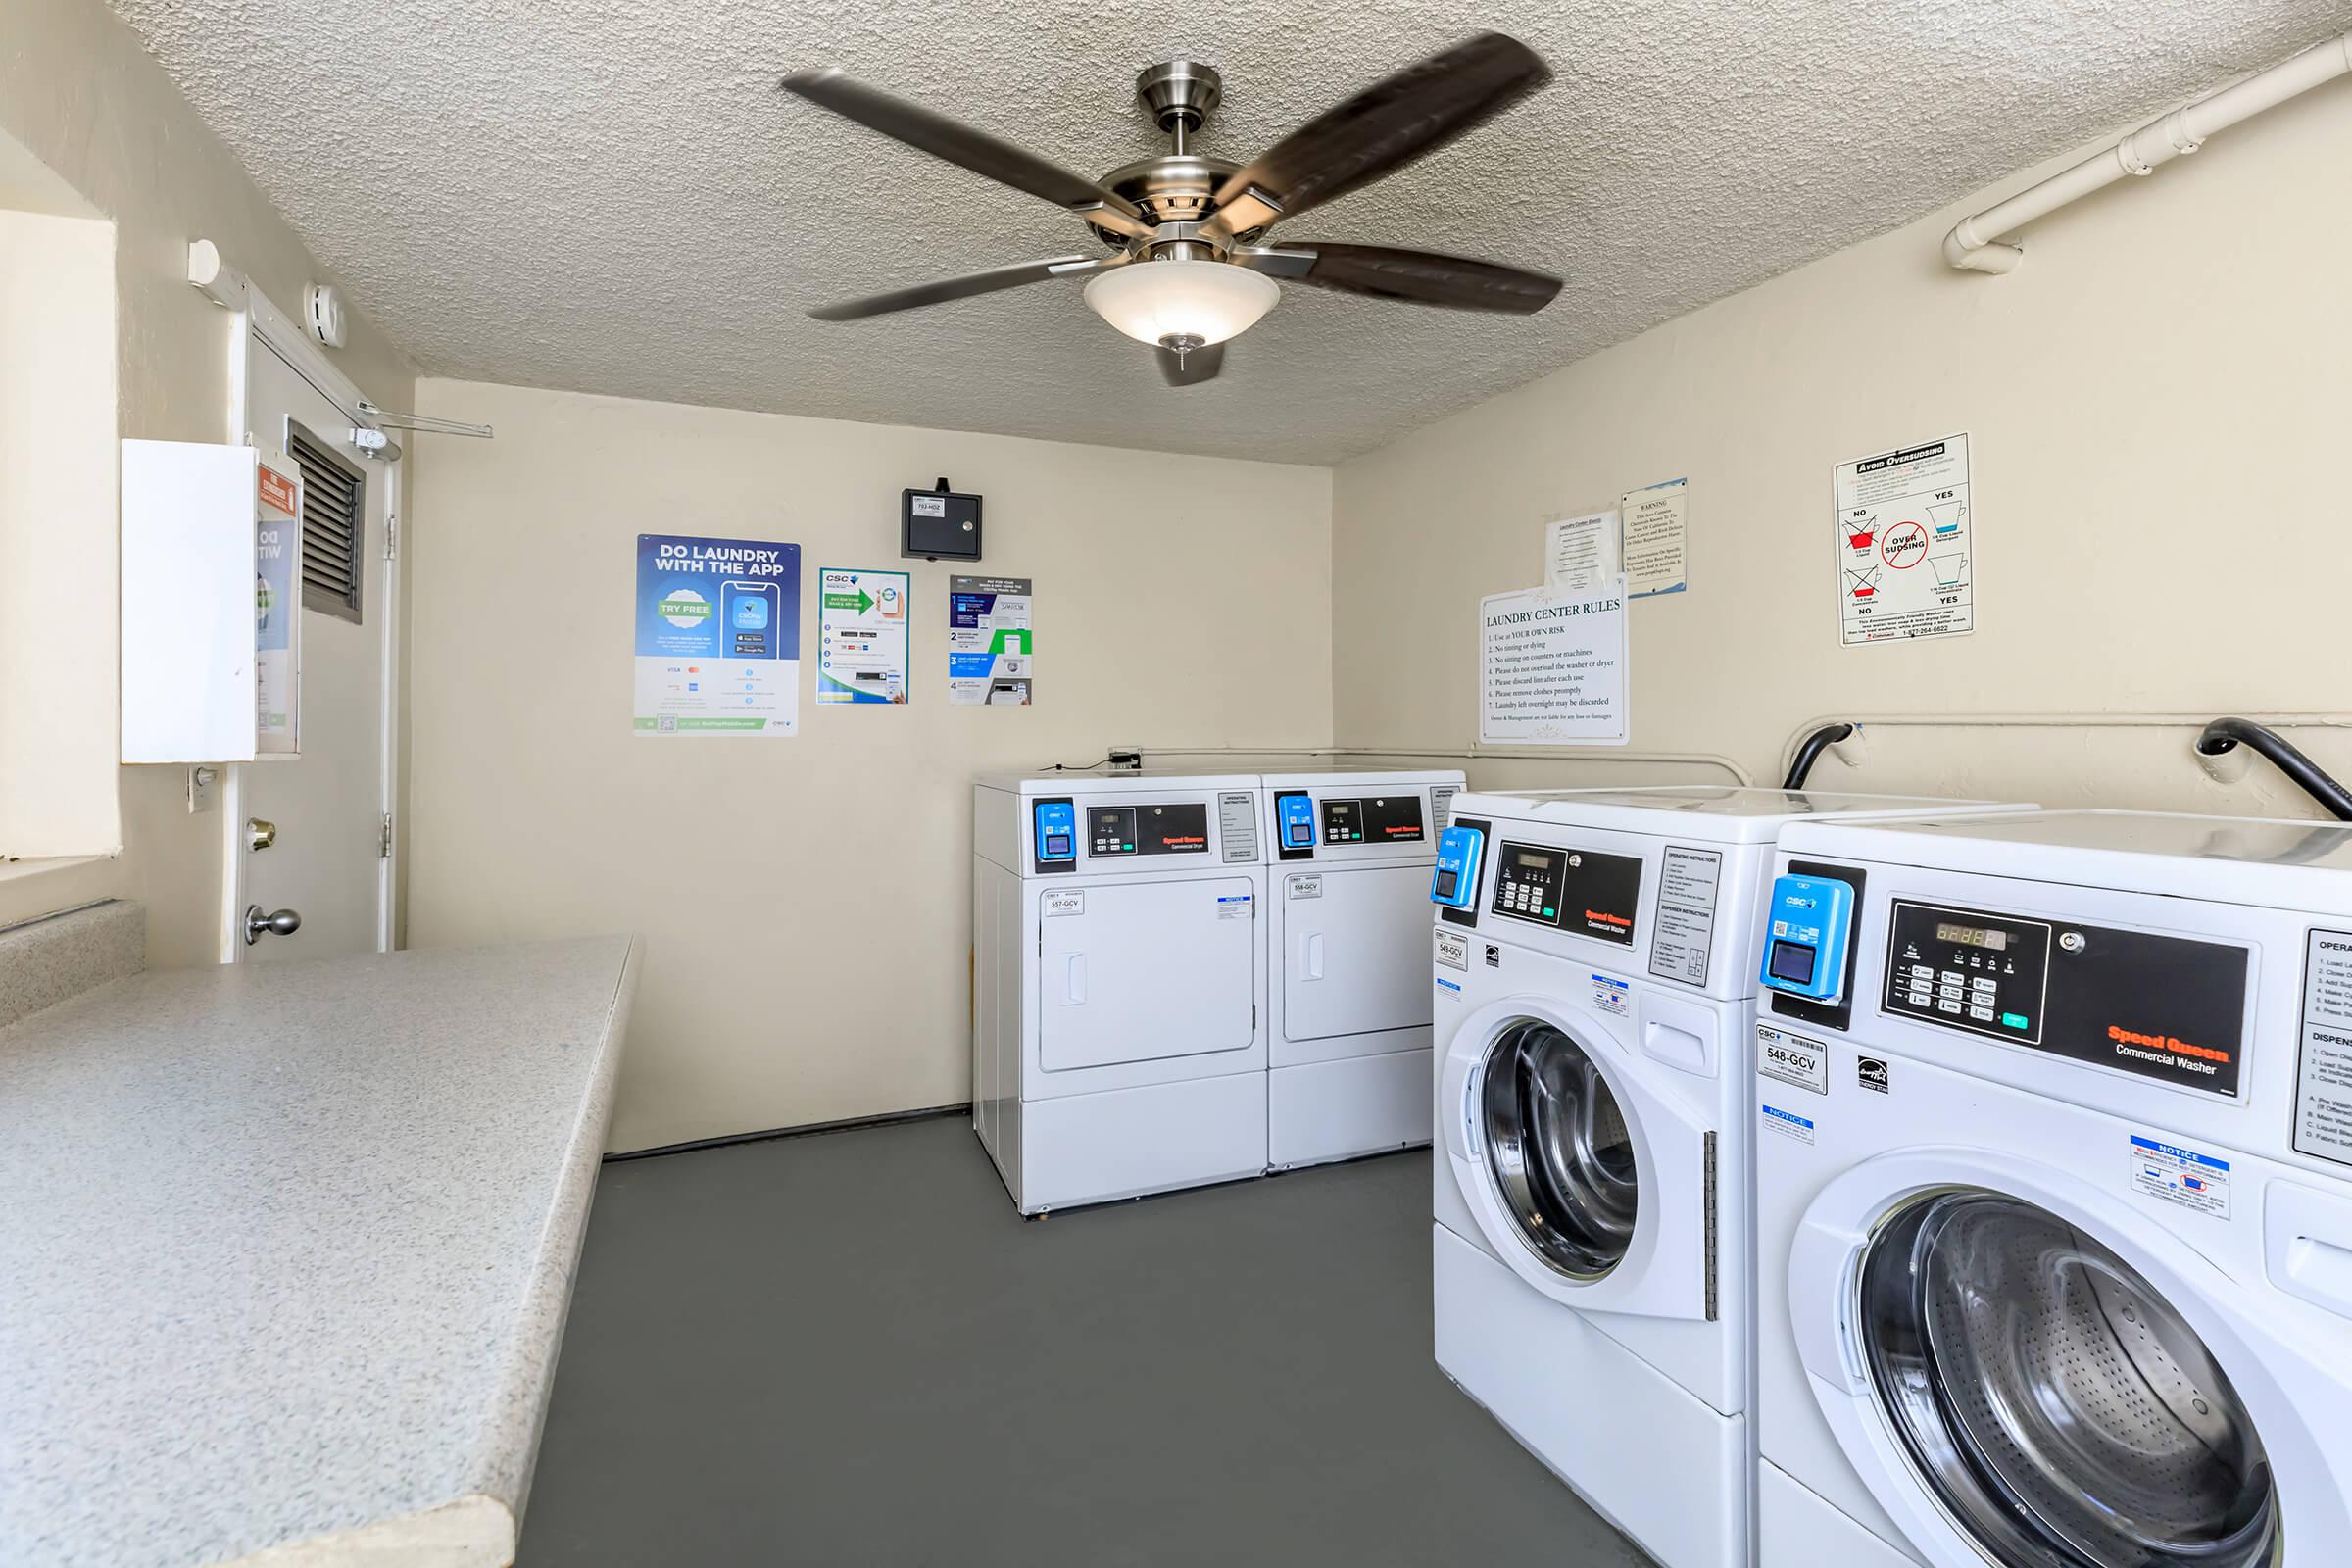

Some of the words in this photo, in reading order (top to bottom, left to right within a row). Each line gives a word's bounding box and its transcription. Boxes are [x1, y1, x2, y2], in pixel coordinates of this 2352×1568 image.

[1935, 490, 1953, 500] YES
[1641, 500, 1667, 510] WARNING
[1853, 509, 1866, 518] NO
[1892, 535, 1917, 545] OVER
[1885, 541, 1925, 554] SUDSING
[660, 544, 688, 557] DO
[693, 546, 779, 563] LAUNDRY
[654, 558, 703, 573] WITH
[709, 561, 743, 575] THE
[748, 564, 784, 576] APP
[952, 595, 956, 604] 1
[1940, 595, 1958, 604] YES
[683, 605, 709, 613] FREE
[1487, 612, 1533, 627] LAUNDRY
[1534, 604, 1580, 620] CENTER
[1583, 598, 1621, 614] RULES
[950, 632, 957, 641] 2
[1511, 630, 1530, 639] YOUR
[1531, 628, 1548, 637] OWN
[1549, 626, 1566, 634] RISK
[1563, 648, 1592, 657] machines
[951, 657, 957, 665] 3
[1531, 664, 1555, 672] overload
[1567, 661, 1587, 669] washer
[1597, 659, 1614, 667] dryer
[1512, 677, 1532, 685] discard
[1558, 674, 1572, 682] each
[950, 682, 957, 690] 4
[1554, 686, 1581, 696] promptly
[1495, 701, 1517, 710] Laundry
[1529, 699, 1555, 708] overnight
[1578, 697, 1609, 705] discarded
[1786, 896, 1807, 906] CSC
[1759, 1029, 1775, 1038] CSC
[2108, 1025, 2165, 1049] Speed
[2166, 1037, 2230, 1063] Queen
[1767, 1047, 1815, 1070] 548-GCV
[2116, 1043, 2174, 1066] Commercial
[2176, 1057, 2217, 1075] Washer
[2318, 1075, 2337, 1084] Close
[1770, 1108, 1806, 1125] NOTICE
[2316, 1124, 2337, 1134] Liquid
[2316, 1134, 2337, 1143] Fabric
[2159, 1144, 2200, 1161] NOTICE
